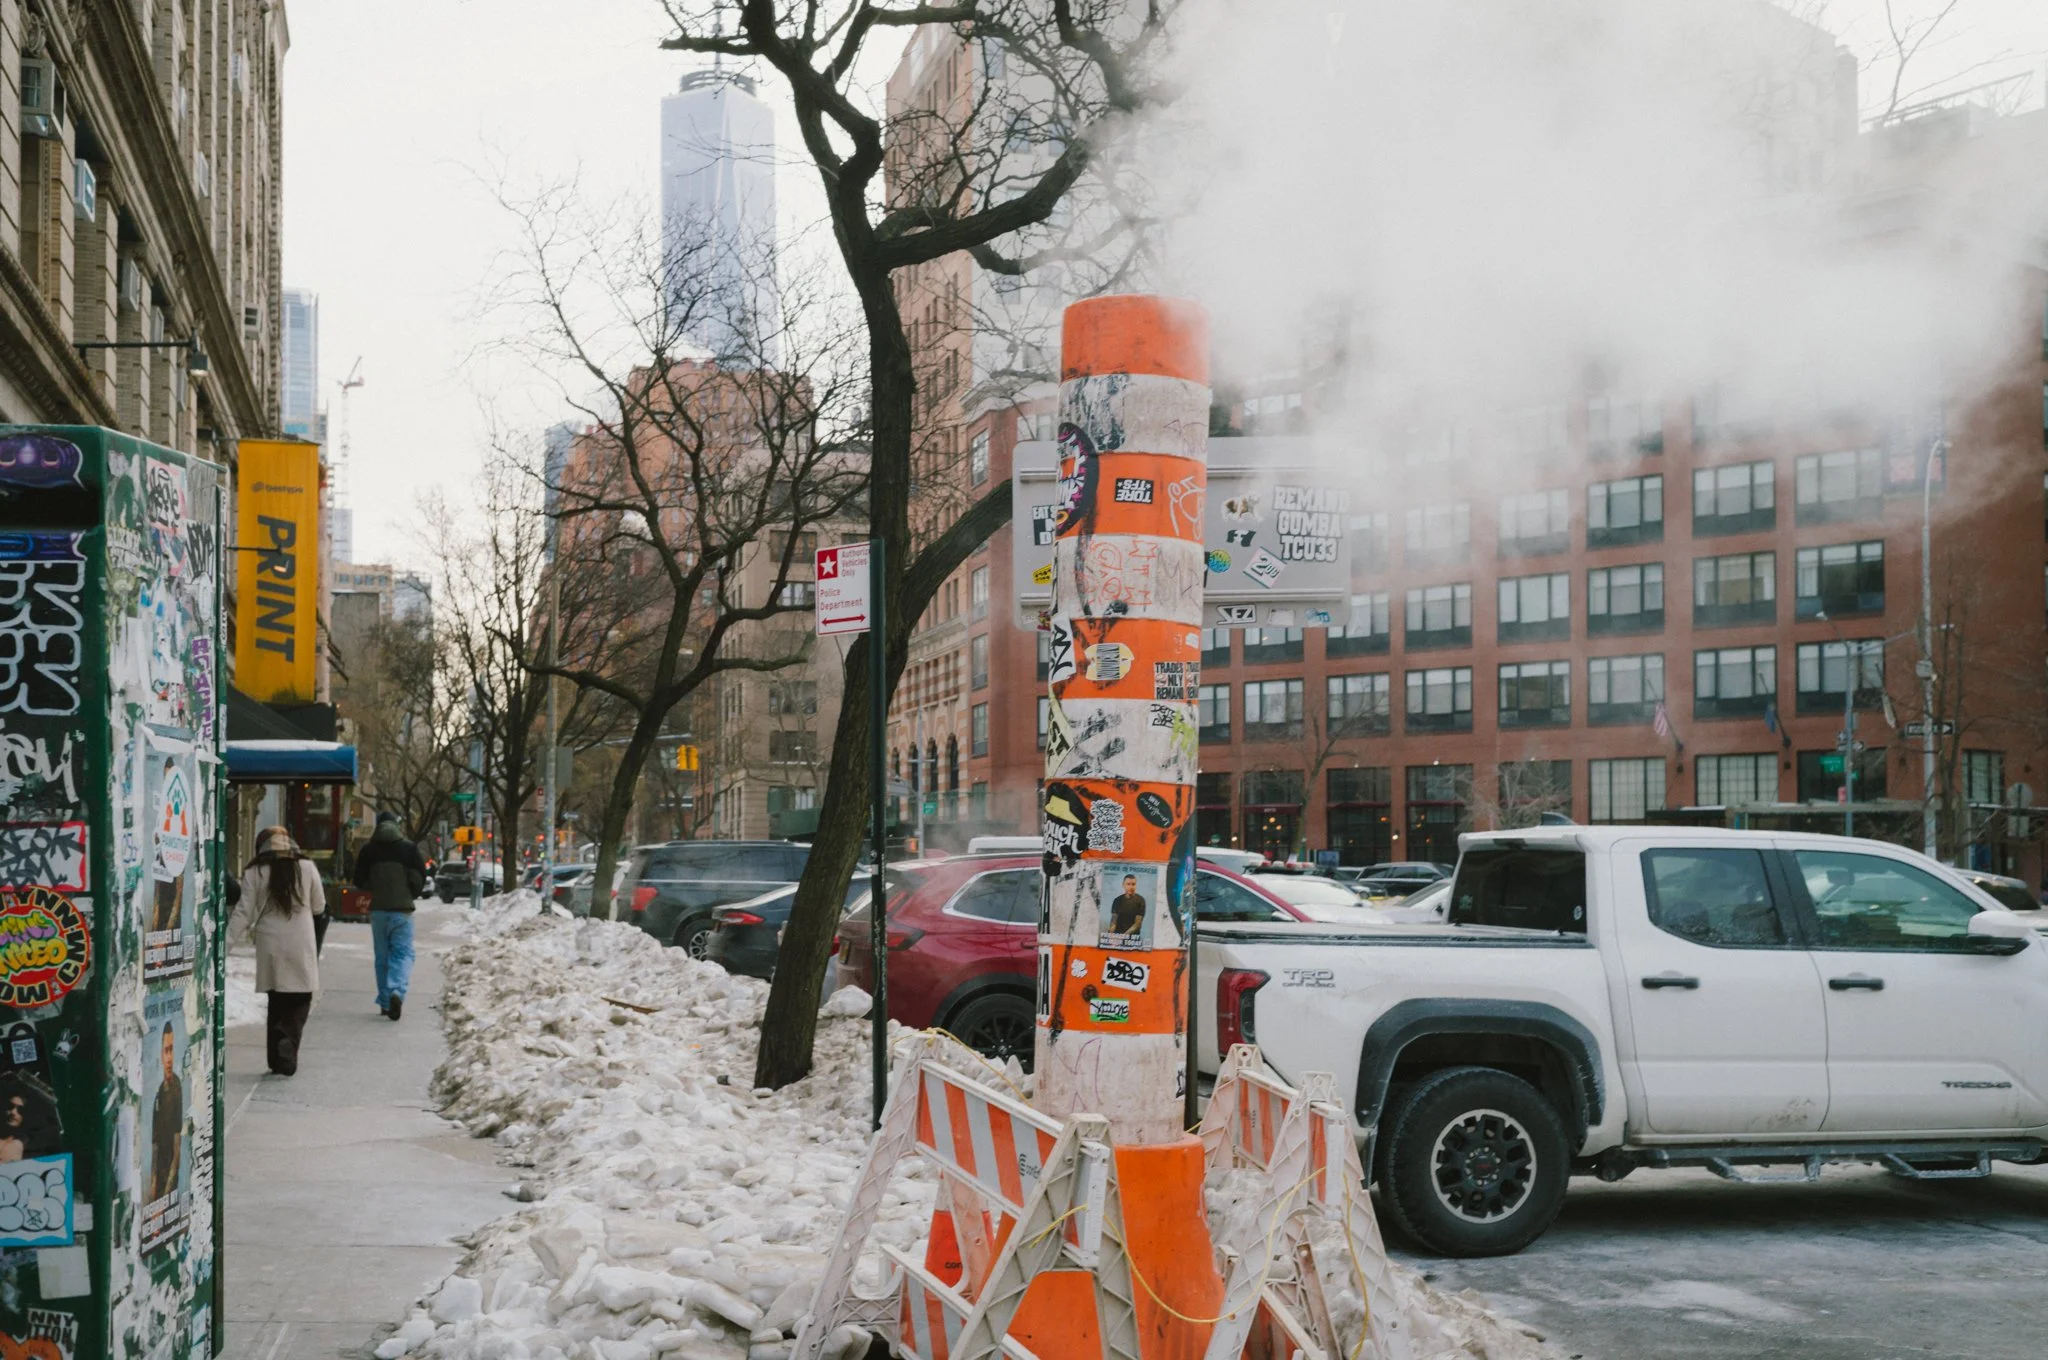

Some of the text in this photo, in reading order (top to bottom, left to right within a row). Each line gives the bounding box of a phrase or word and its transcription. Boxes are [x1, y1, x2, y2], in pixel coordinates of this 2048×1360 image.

[255, 514, 297, 664] PRINT
[820, 589, 840, 598] Police
[820, 598, 863, 611] Department
[1283, 969, 1334, 984] TRD
